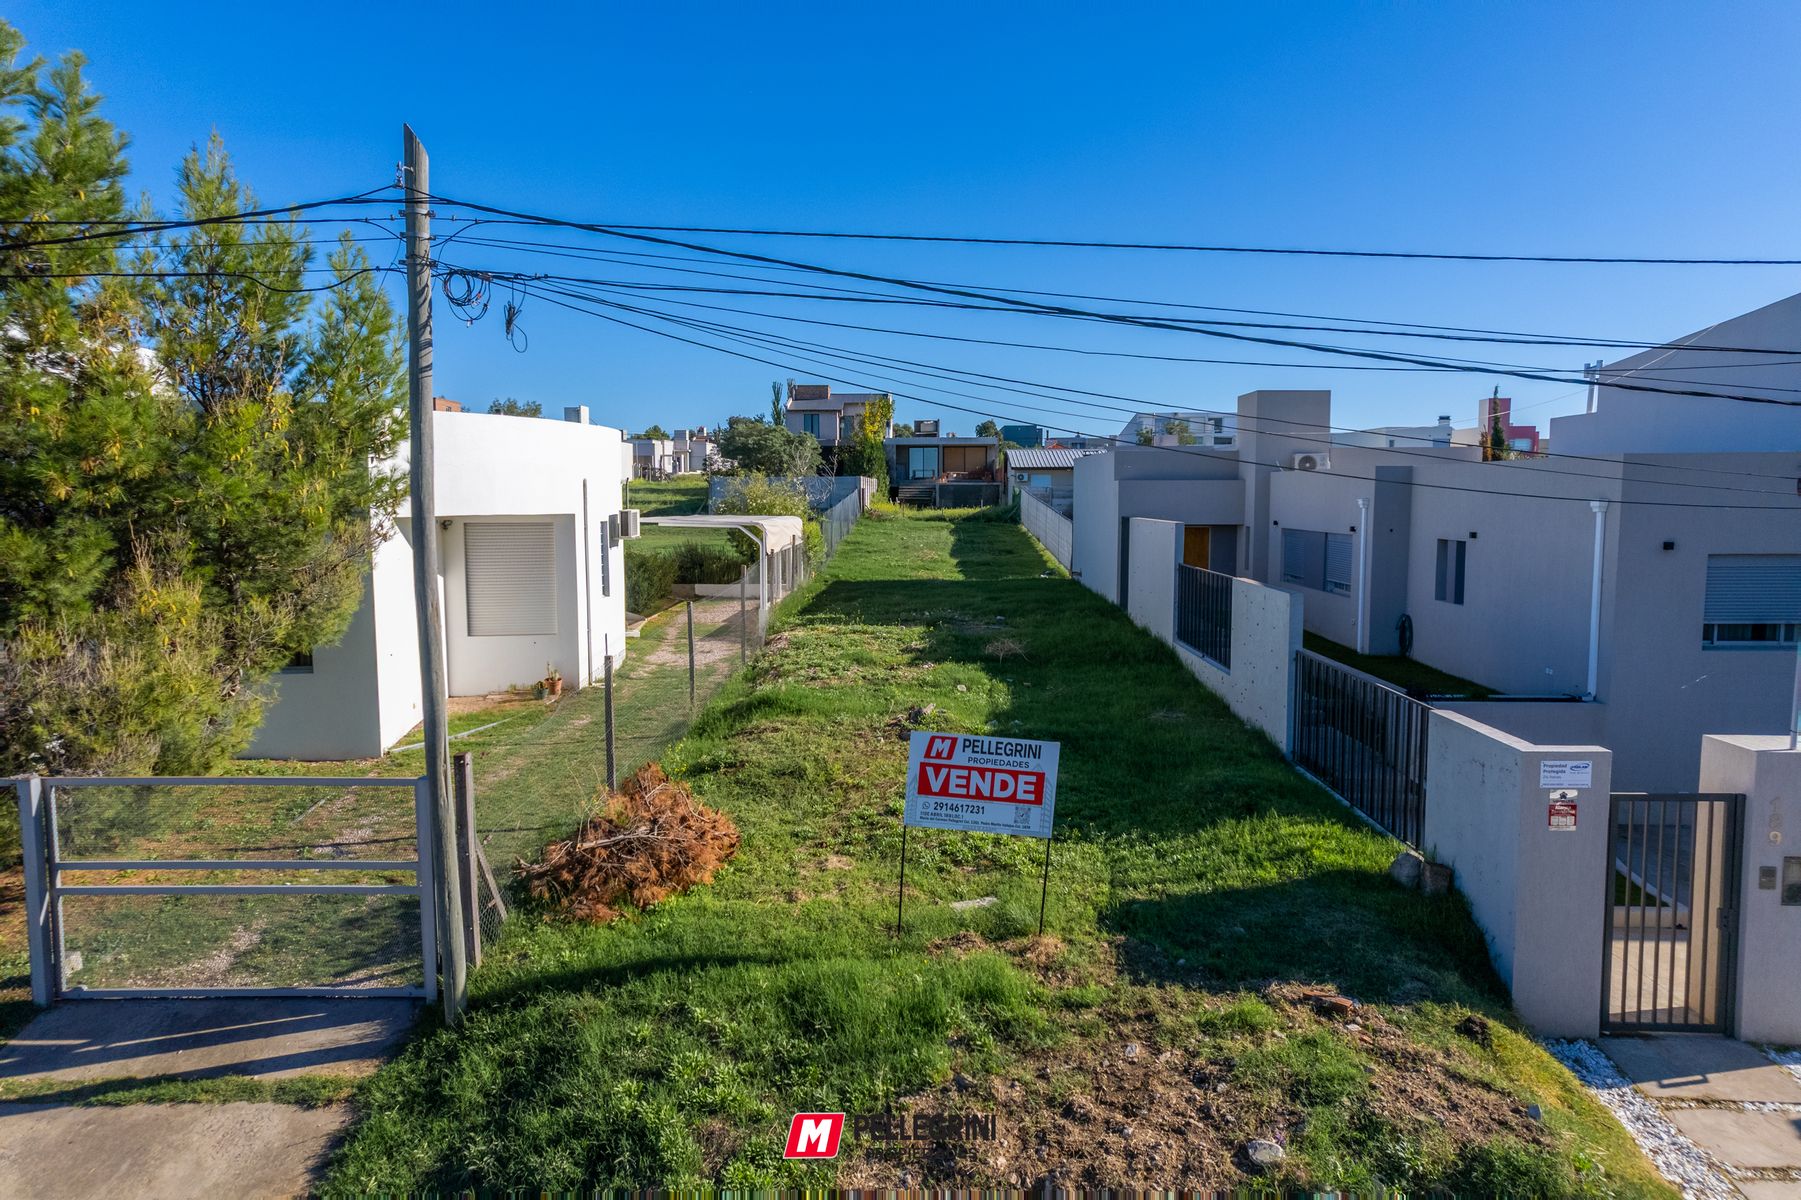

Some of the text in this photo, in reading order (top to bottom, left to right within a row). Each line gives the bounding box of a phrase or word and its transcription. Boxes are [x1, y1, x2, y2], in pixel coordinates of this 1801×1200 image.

[930, 738, 952, 758] M
[962, 738, 1042, 760] PELLEGRINI
[967, 756, 1030, 769] PROPIEDADES
[925, 766, 1037, 801] VENDE
[933, 801, 985, 815] 2914617231
